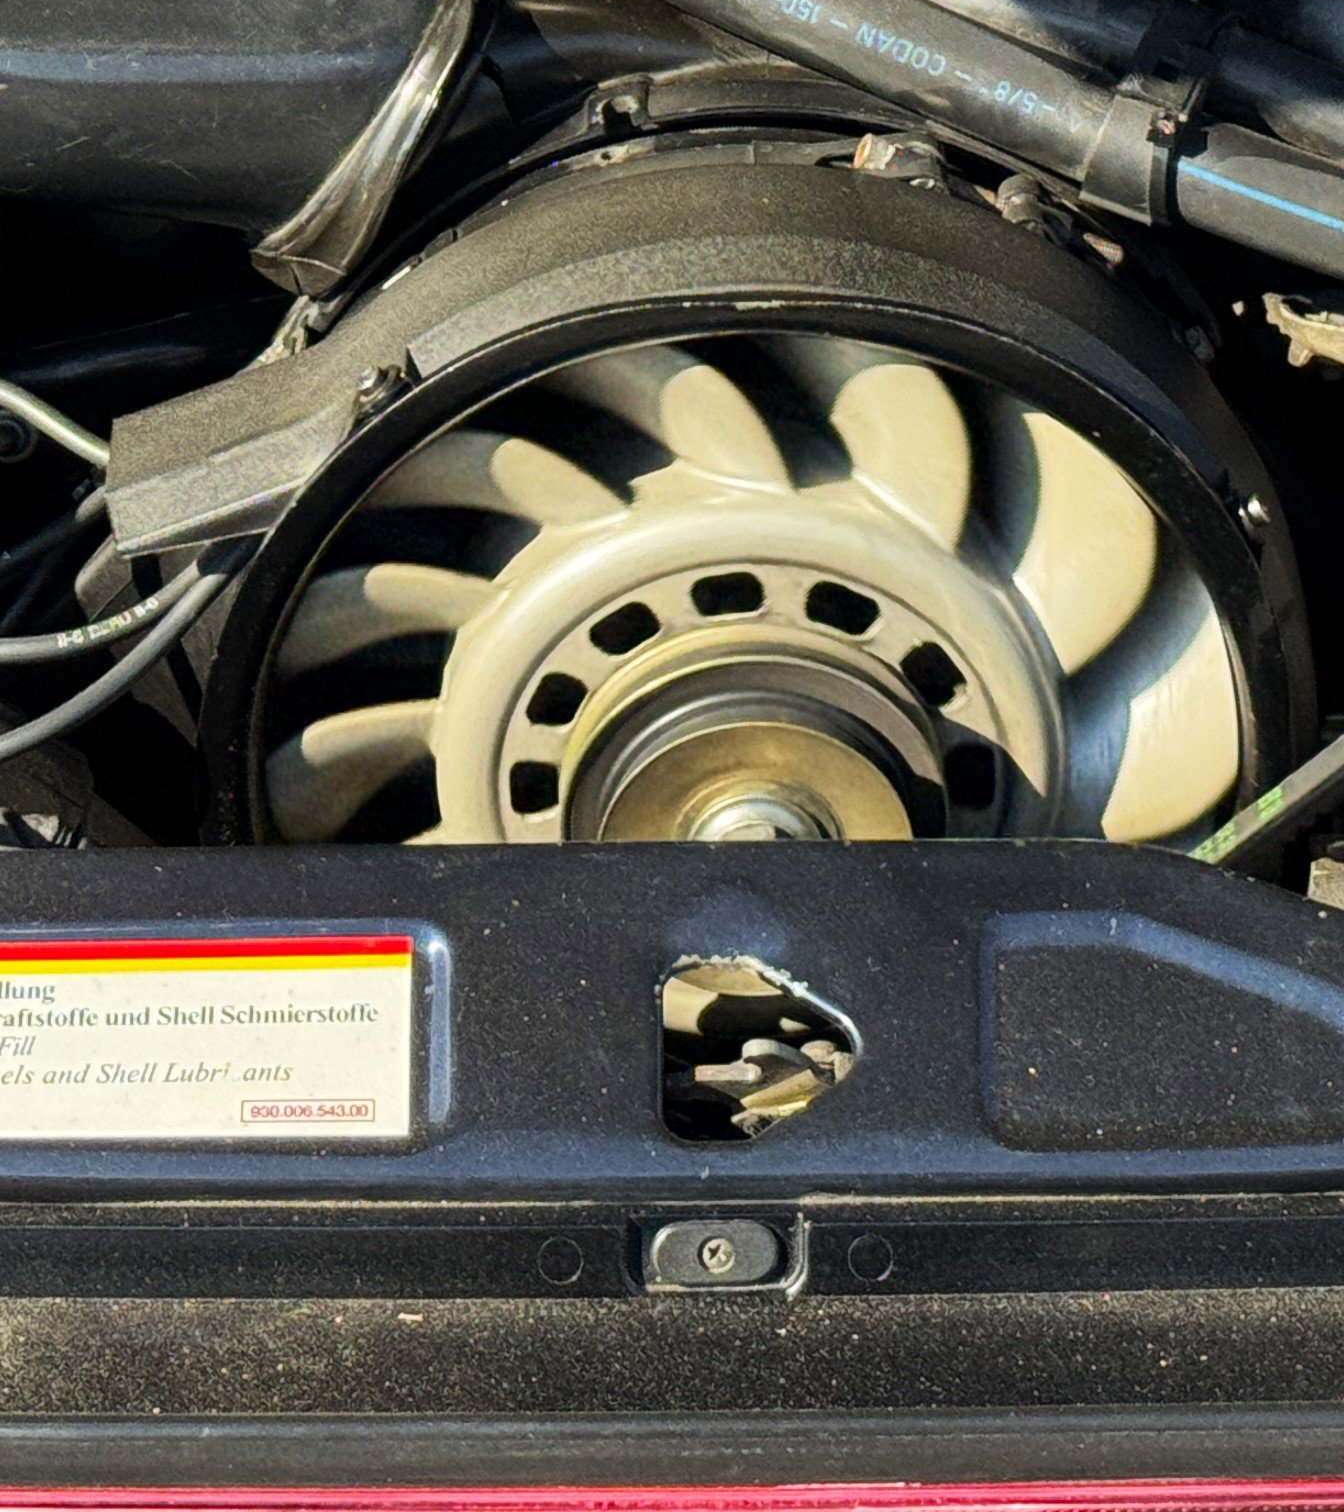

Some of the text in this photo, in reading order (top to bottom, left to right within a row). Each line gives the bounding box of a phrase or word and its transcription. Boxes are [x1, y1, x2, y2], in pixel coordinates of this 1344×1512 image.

[855, 22, 948, 77] CODAN
[105, 1007, 150, 1026] und
[157, 1006, 215, 1026] Shell
[219, 1003, 379, 1024] Schmierstoffe
[42, 1063, 92, 1084] and
[96, 1062, 158, 1083] Shell
[162, 1061, 295, 1084] Lubriants
